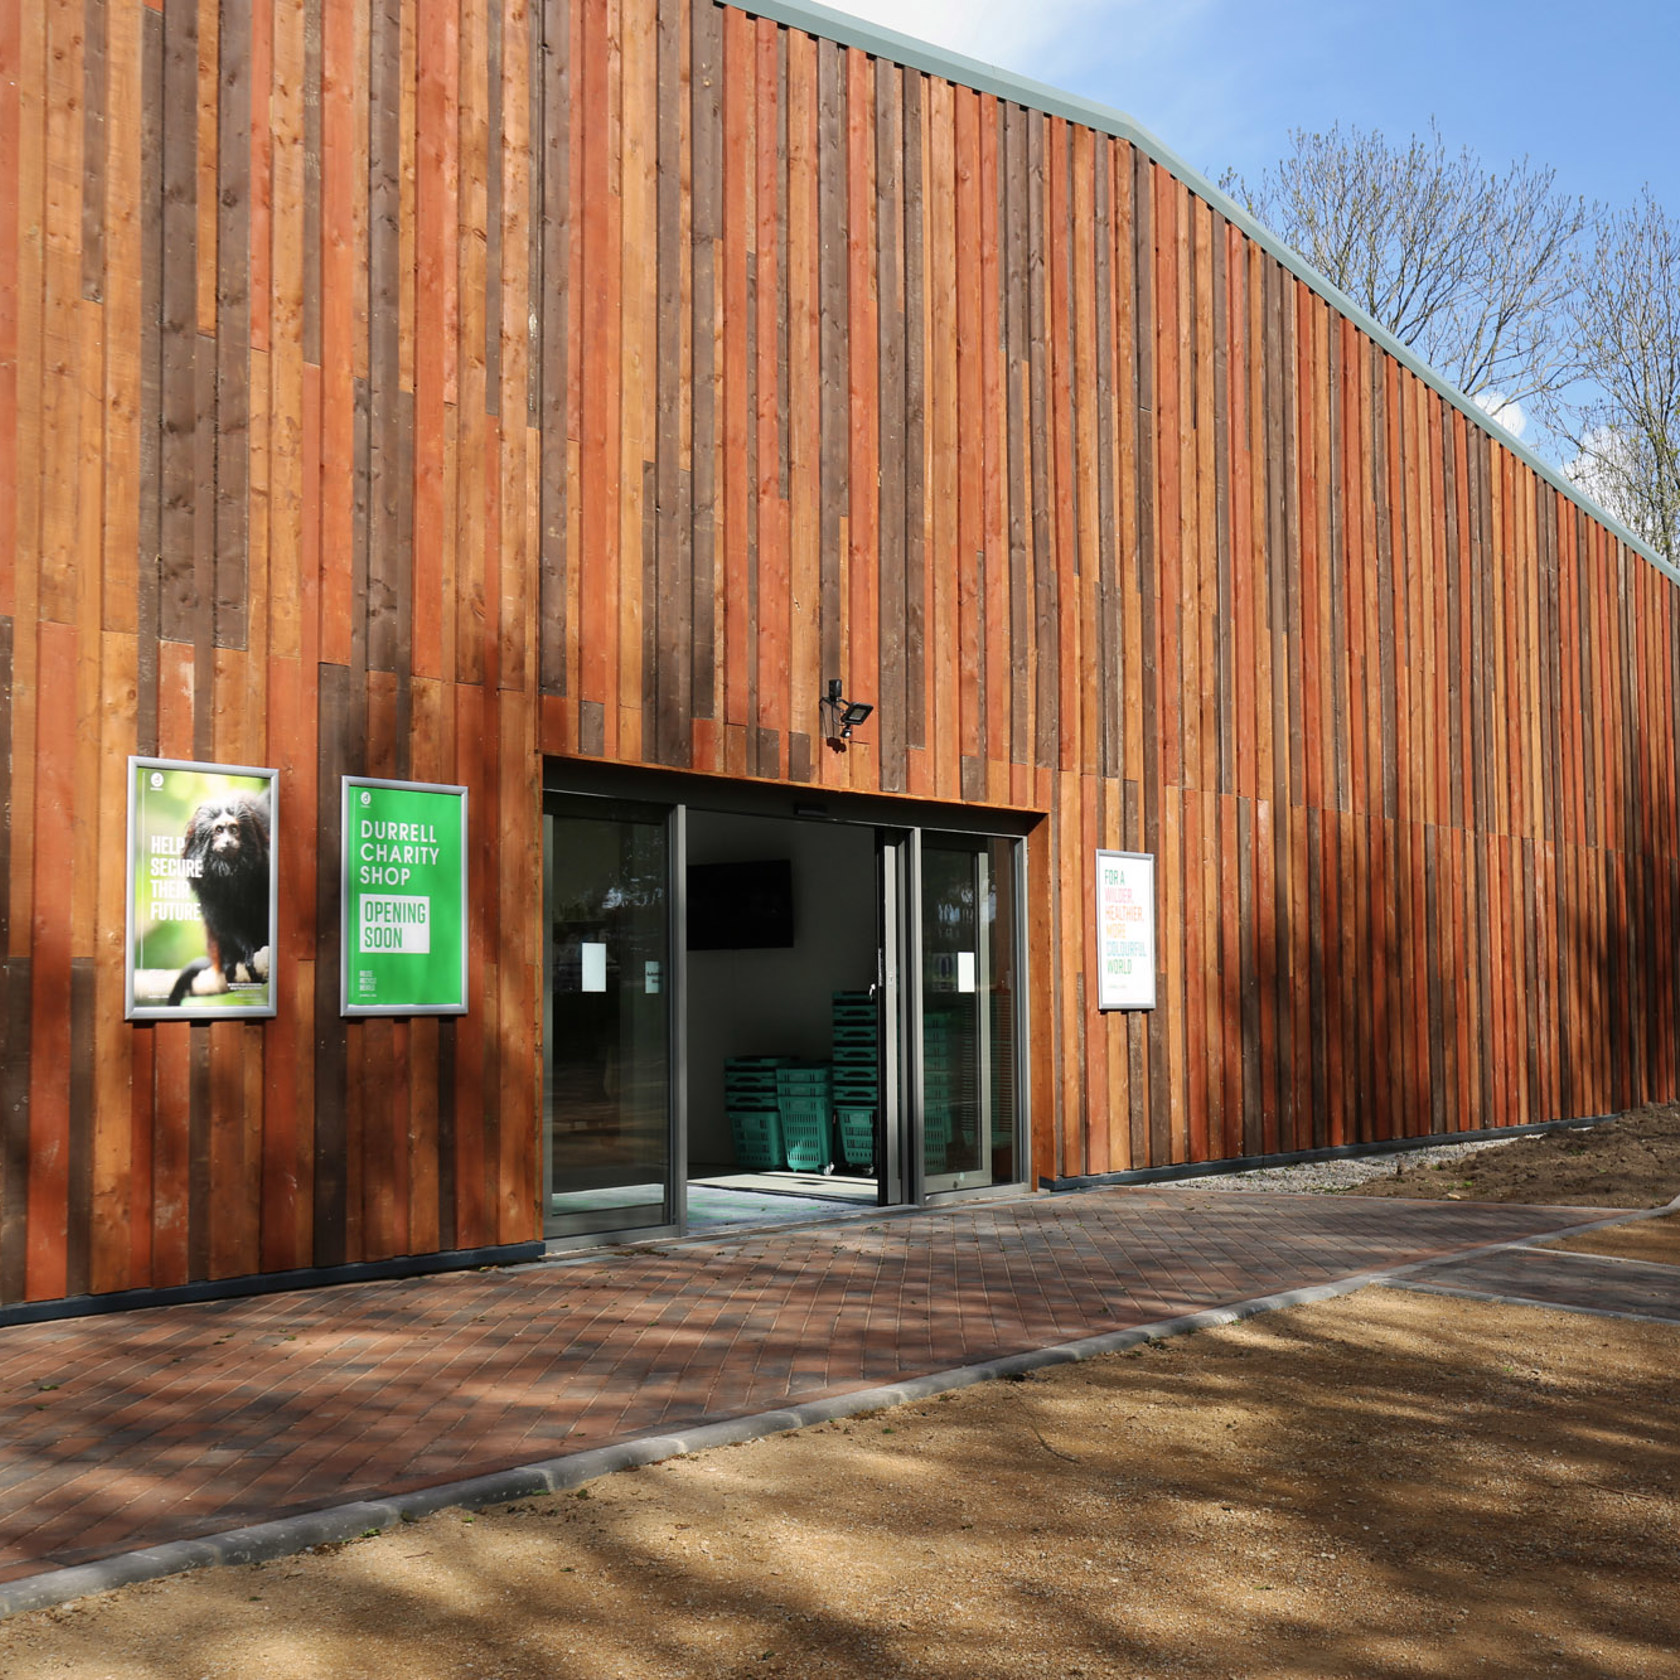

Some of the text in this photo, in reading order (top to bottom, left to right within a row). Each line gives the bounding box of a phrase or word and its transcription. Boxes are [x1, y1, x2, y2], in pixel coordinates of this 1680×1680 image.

[360, 820, 437, 843] DURRELL
[151, 836, 185, 854] HELP
[360, 843, 440, 865] CHARITY
[151, 857, 203, 878] SECURE
[360, 865, 411, 886] SHOP
[1104, 869, 1125, 885] FOR A
[150, 879, 191, 899] THEIR
[151, 902, 201, 921] FUTURE
[365, 901, 426, 924] OPENING
[364, 926, 402, 948] SOON
[1106, 923, 1126, 939] MORE
[1106, 941, 1147, 957] COLOURFUL
[1107, 959, 1132, 975] WORLD
